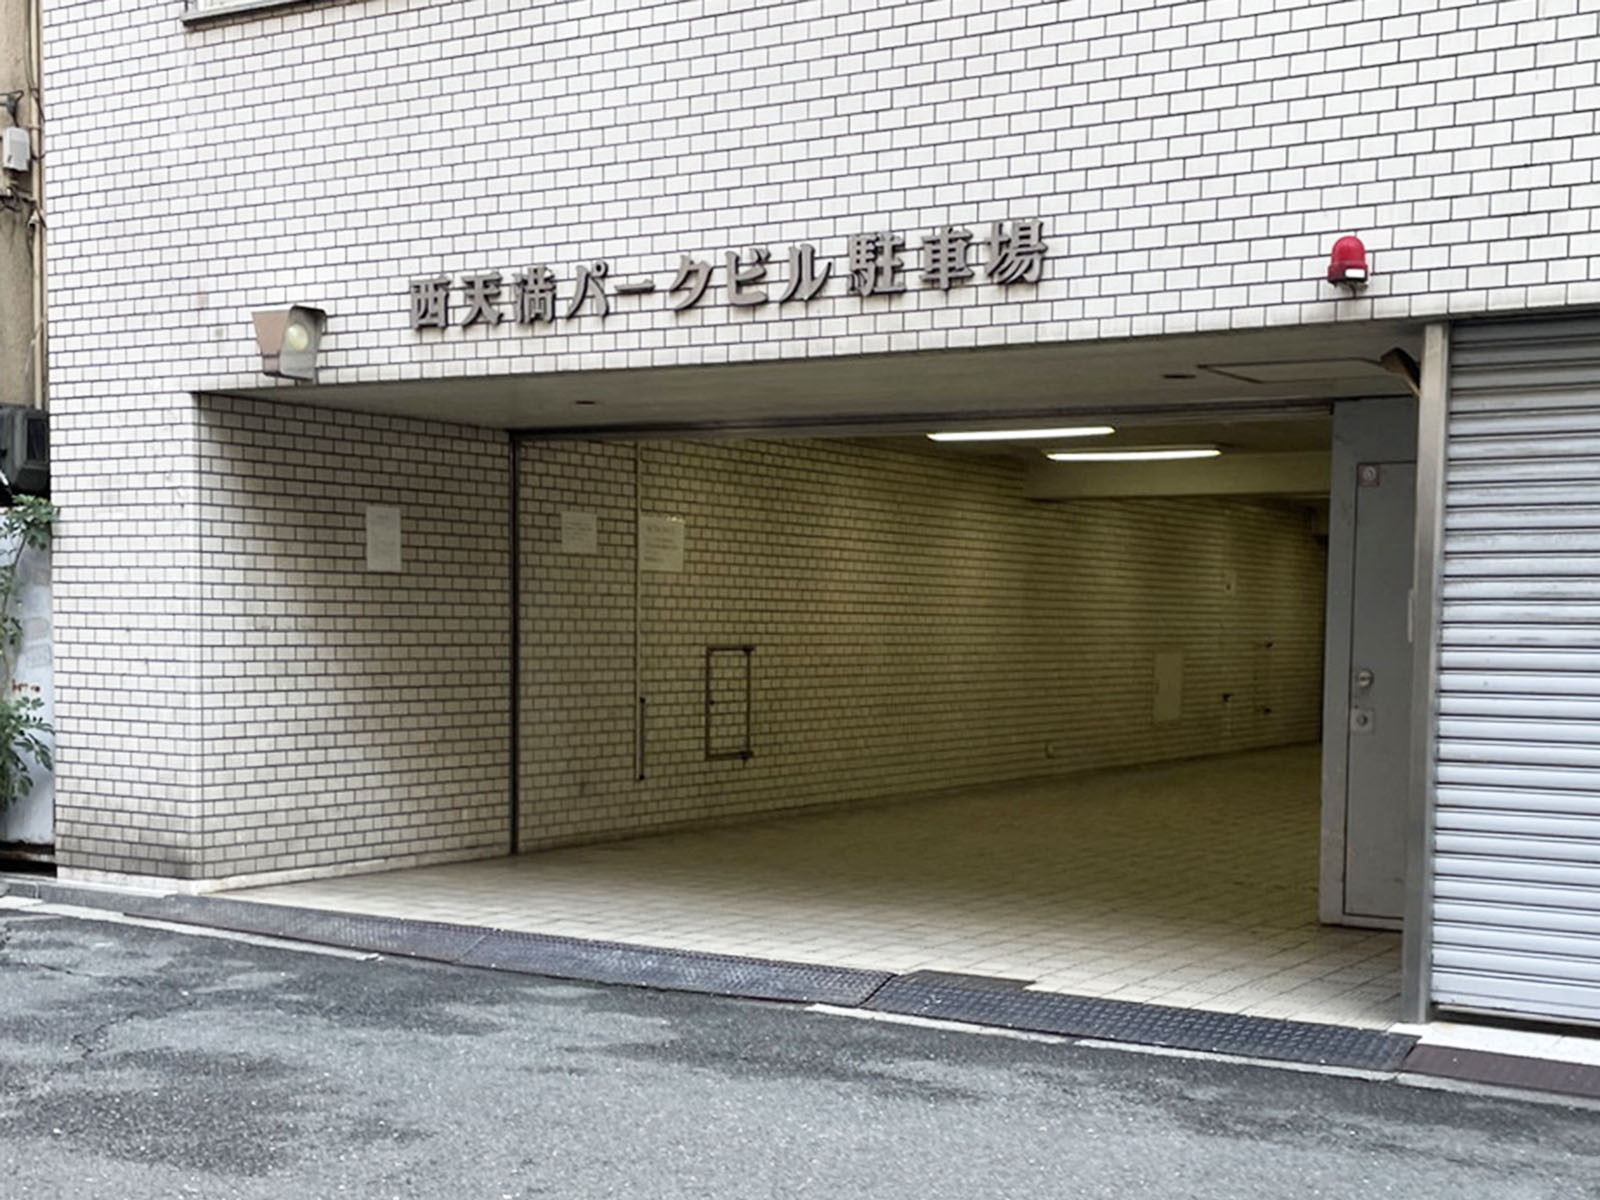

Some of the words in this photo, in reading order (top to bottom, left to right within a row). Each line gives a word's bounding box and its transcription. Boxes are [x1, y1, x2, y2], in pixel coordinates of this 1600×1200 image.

[410, 217, 1047, 331] 西天満パークビル駐車場
